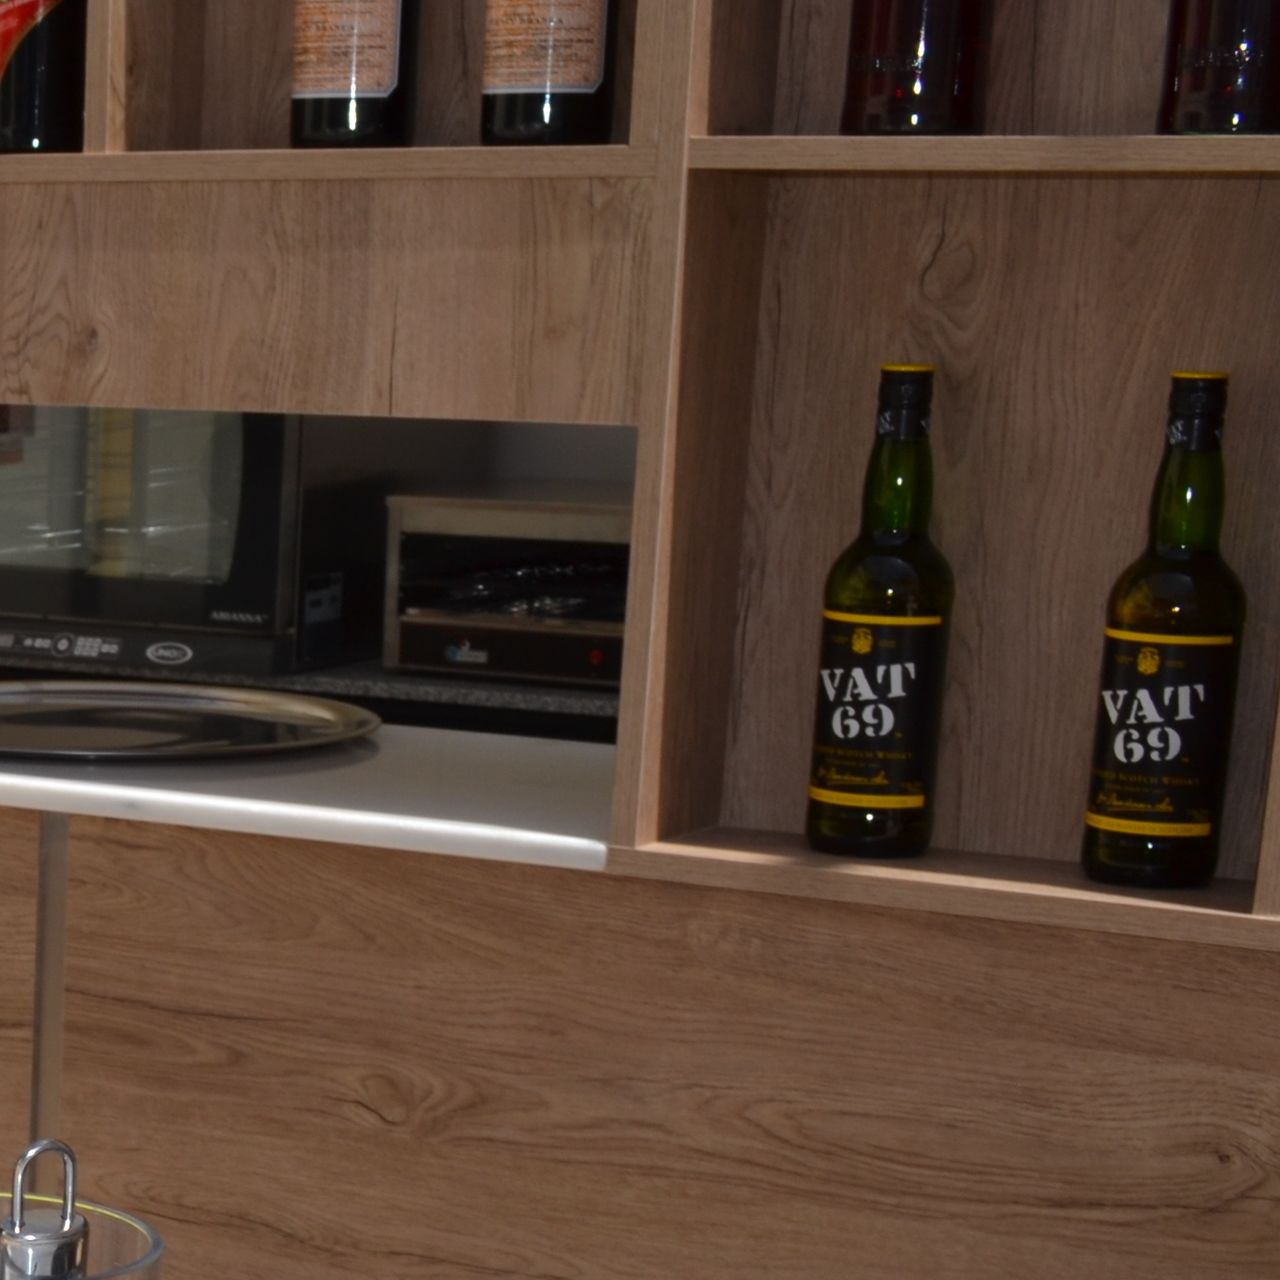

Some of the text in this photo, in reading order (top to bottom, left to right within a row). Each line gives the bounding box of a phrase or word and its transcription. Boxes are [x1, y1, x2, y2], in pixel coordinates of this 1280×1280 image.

[820, 662, 916, 703] VAT
[831, 703, 895, 739] 69
[1101, 683, 1206, 726] VAT
[1113, 726, 1182, 764] 69
